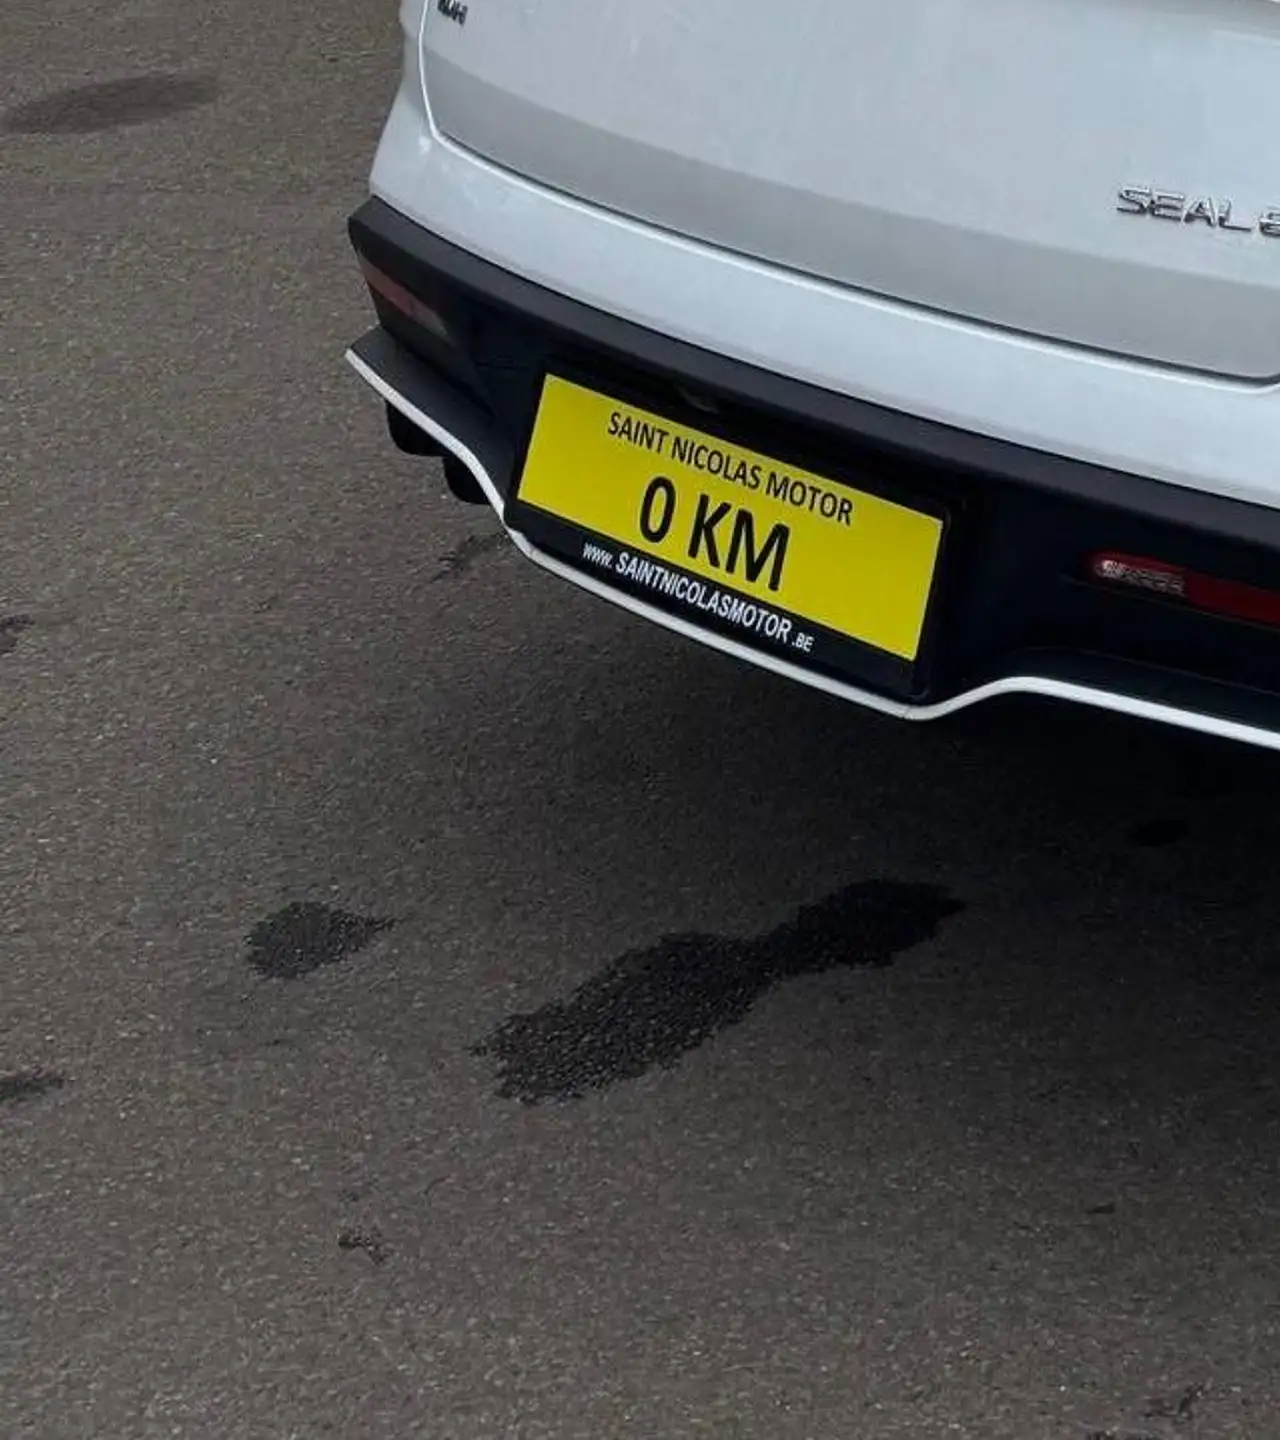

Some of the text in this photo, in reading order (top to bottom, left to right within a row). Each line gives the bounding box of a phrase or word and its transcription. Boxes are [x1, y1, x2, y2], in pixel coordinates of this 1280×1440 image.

[1116, 187, 1252, 233] SEAL
[607, 410, 854, 526] SAINT NICOLAS MOTOR
[639, 475, 791, 592] 0 KM
[615, 551, 793, 643] SAINTNICOLASMOTOR
